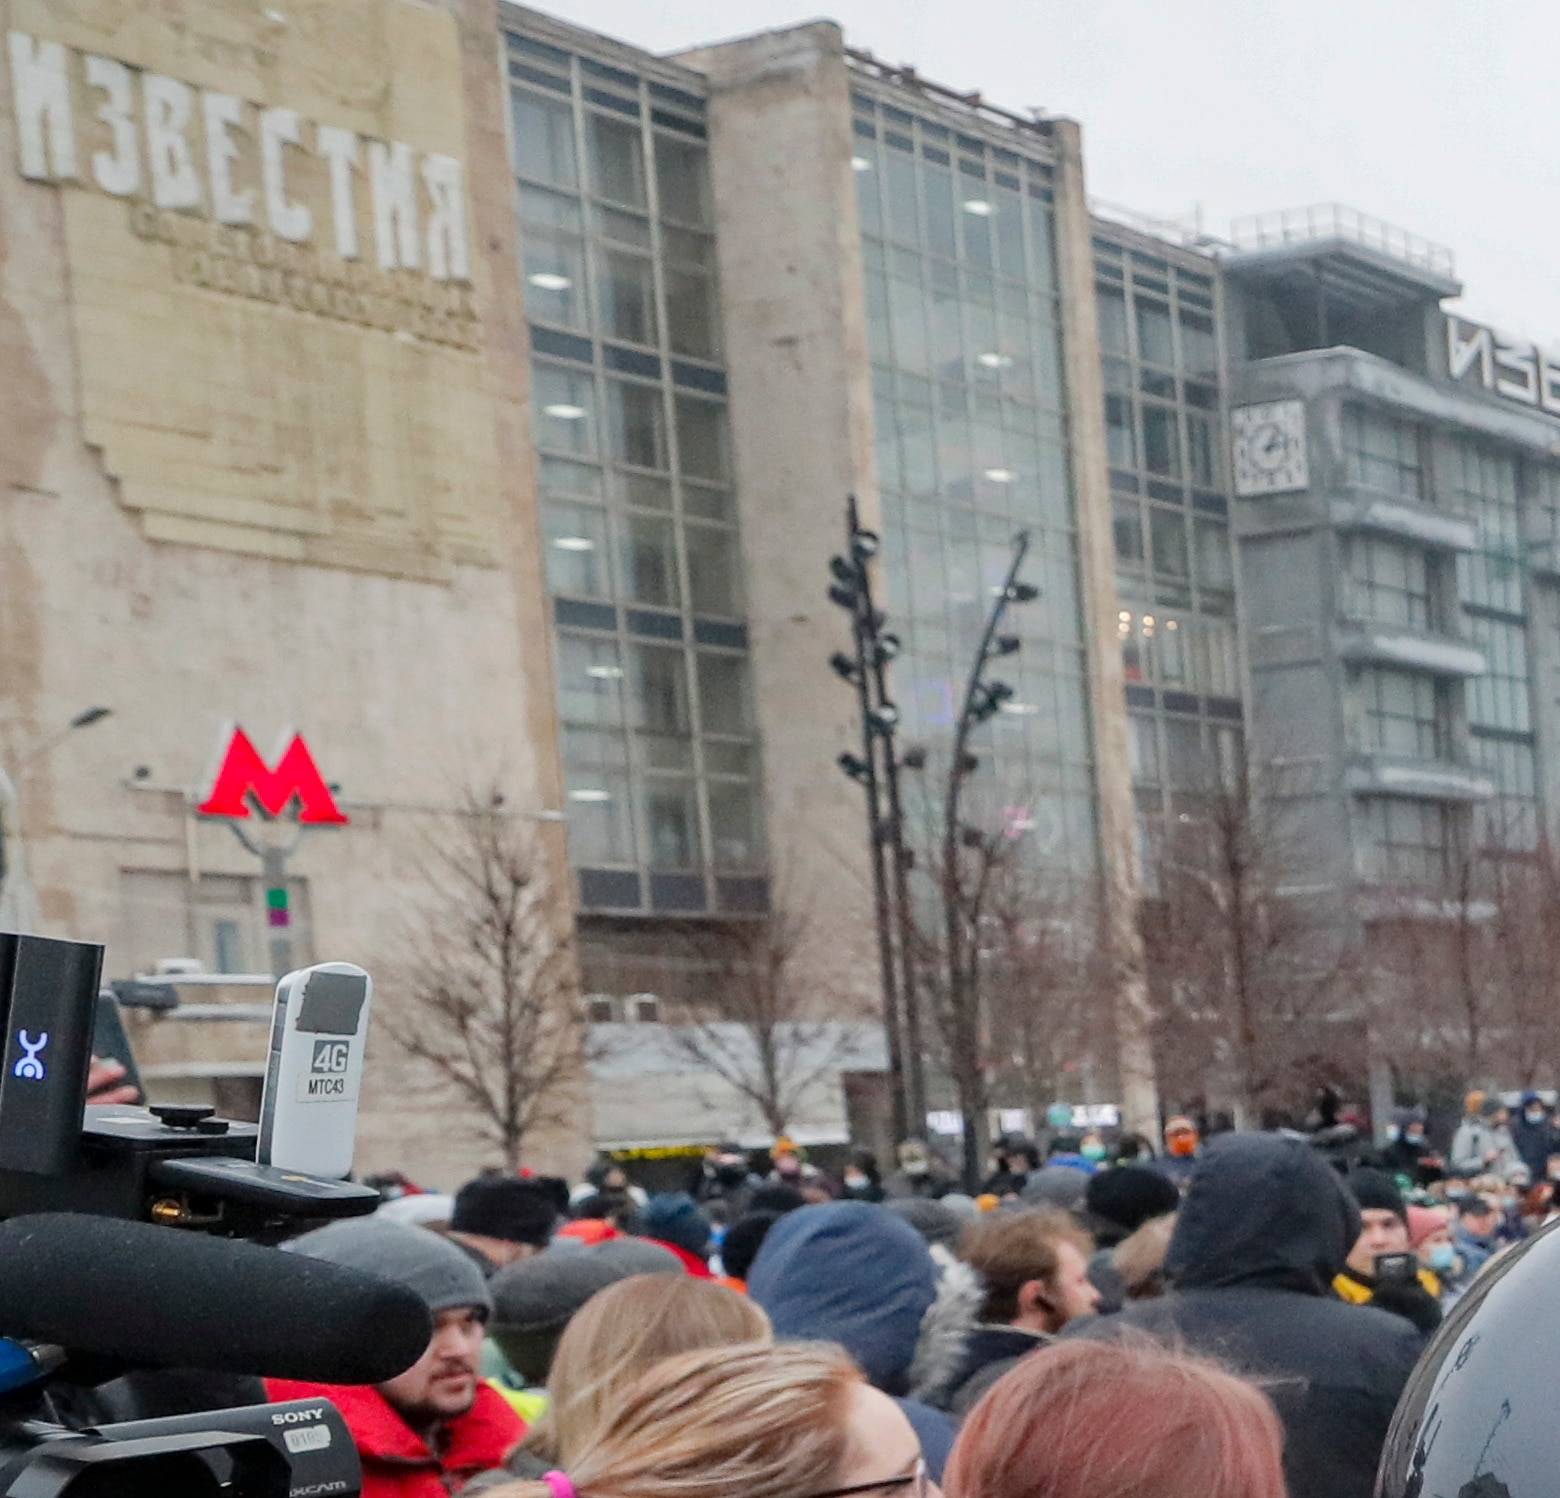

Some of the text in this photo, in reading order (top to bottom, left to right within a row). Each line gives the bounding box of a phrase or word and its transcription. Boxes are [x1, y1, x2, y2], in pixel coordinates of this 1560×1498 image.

[8, 32, 470, 280] ИЗВЕСТИЯ
[313, 1044, 347, 1072] 4G
[271, 1408, 323, 1425] SONY
